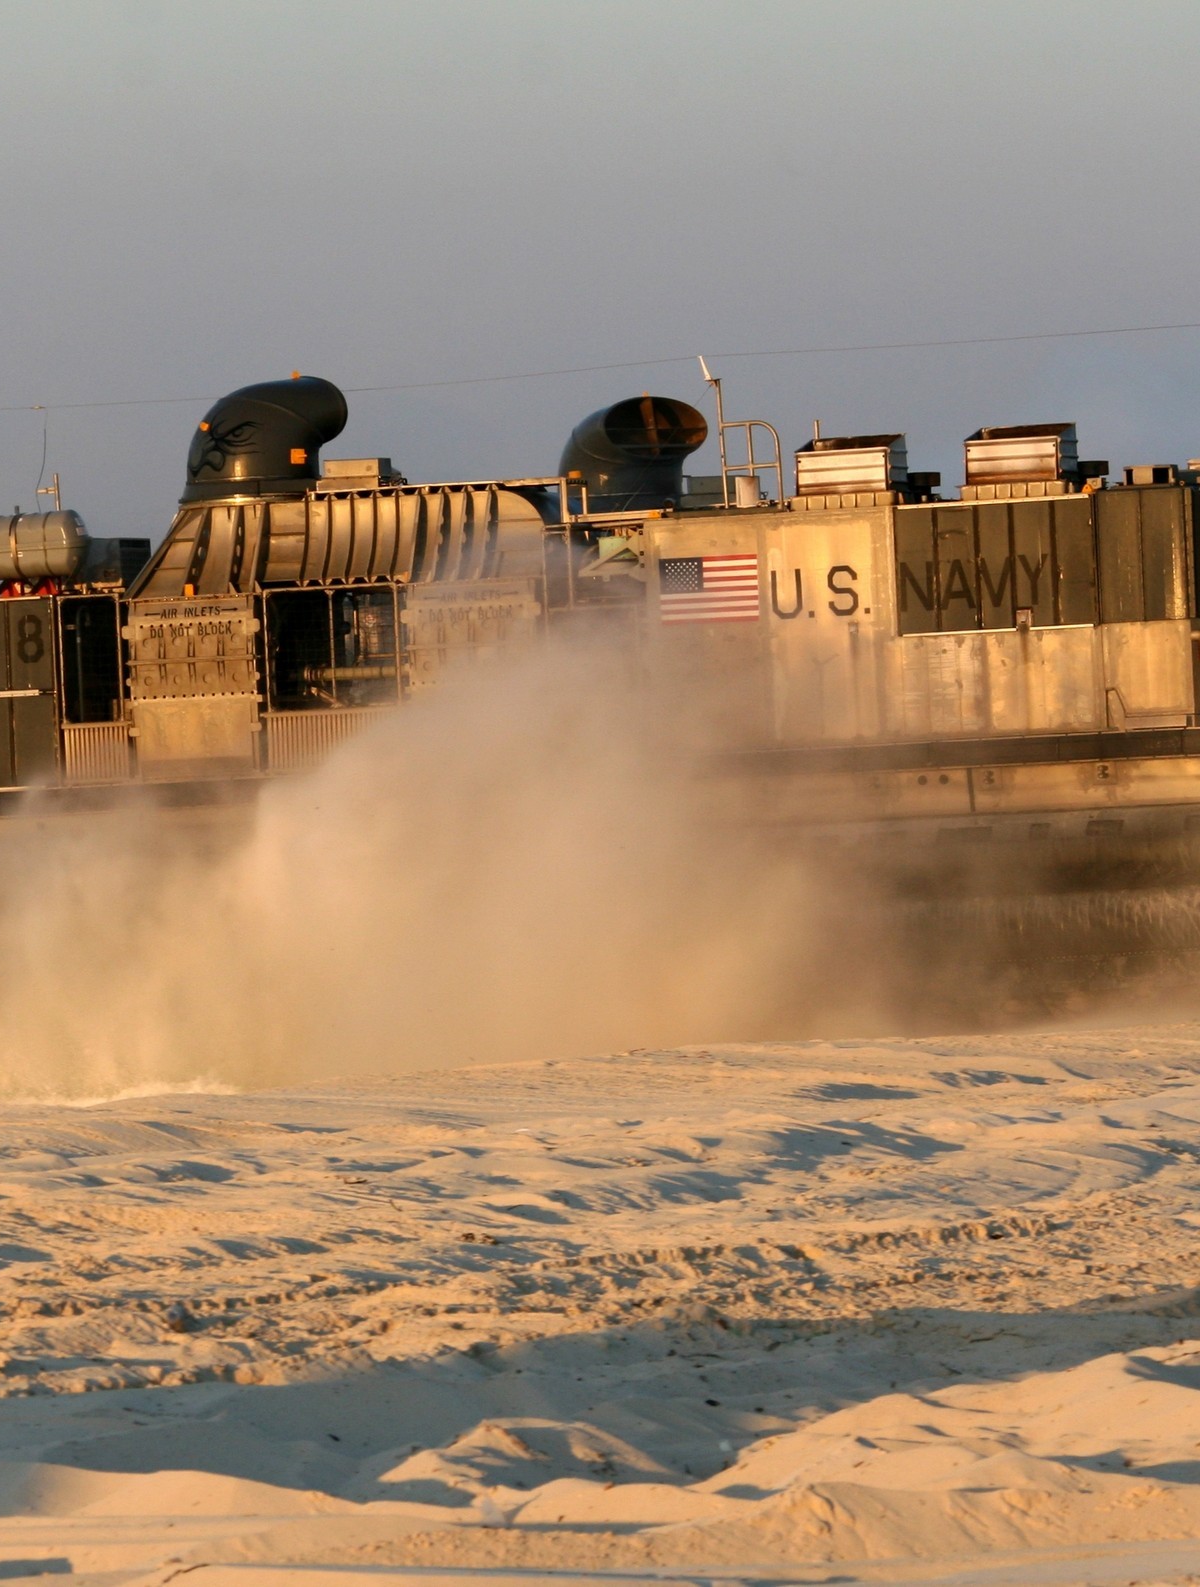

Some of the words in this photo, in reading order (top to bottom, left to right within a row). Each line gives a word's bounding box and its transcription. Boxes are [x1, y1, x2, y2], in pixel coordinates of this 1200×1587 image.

[770, 565, 871, 619] U.S.
[899, 553, 1048, 612] NAVY
[441, 592, 457, 602] AIR
[464, 590, 500, 601] INLETS
[160, 608, 178, 619] AIR
[184, 606, 221, 617] INLETS
[429, 610, 444, 622] DO
[450, 609, 470, 621] NOT
[478, 607, 512, 619] BLOCK
[150, 627, 164, 639] DO
[170, 626, 191, 638] NOT
[197, 624, 232, 636] BLOCK
